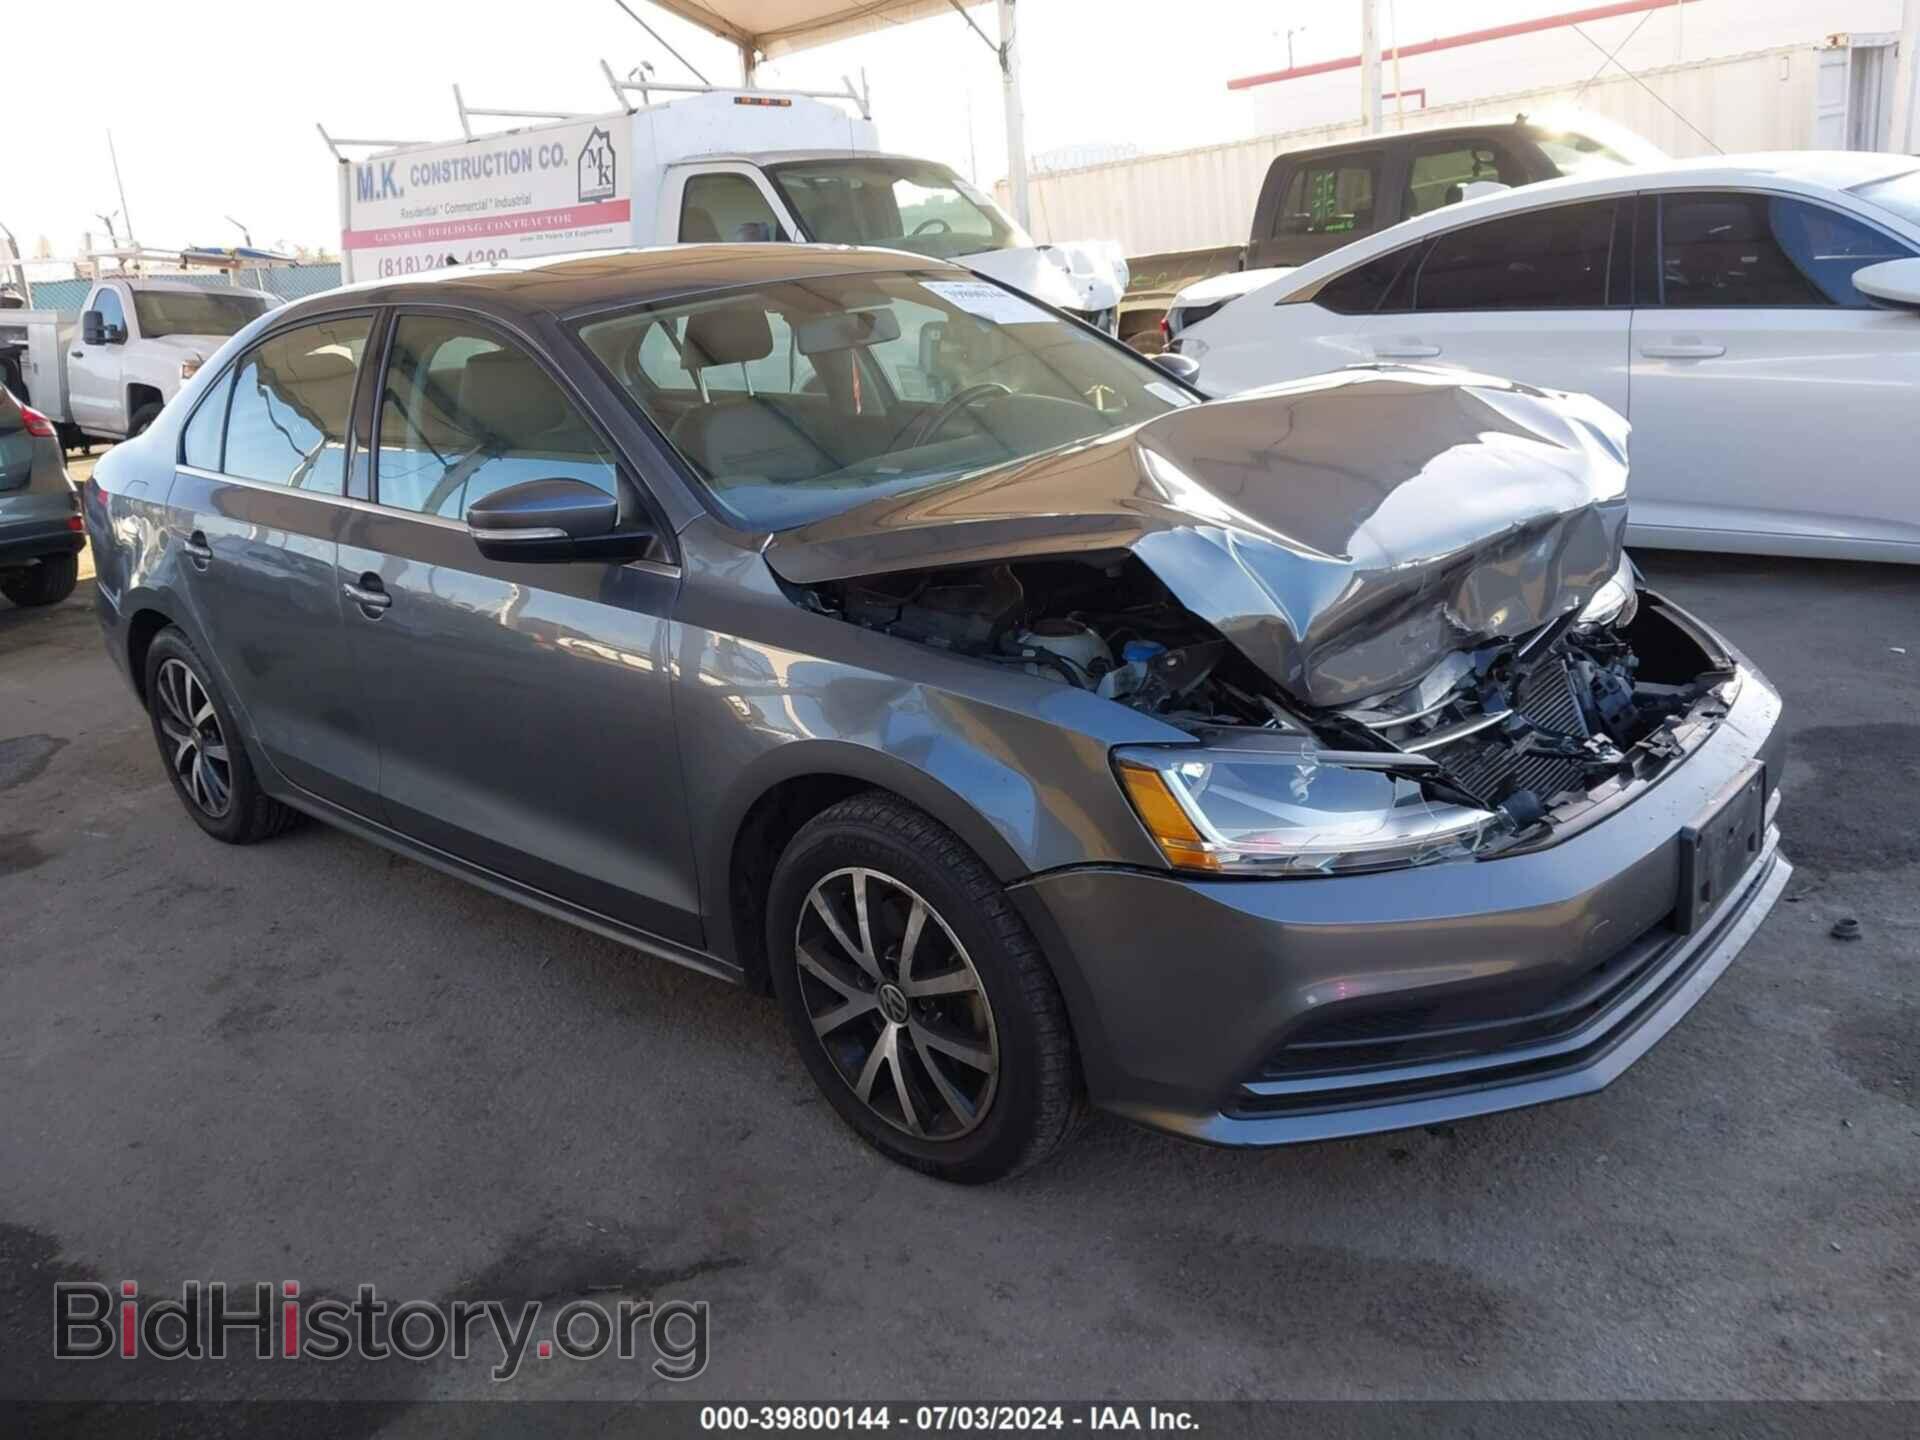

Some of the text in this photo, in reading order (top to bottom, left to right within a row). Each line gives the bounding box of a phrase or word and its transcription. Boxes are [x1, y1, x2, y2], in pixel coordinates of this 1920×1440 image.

[357, 142, 568, 203] M.K. CONSTRUCTION CO.
[428, 223, 483, 238] BUILDING
[487, 213, 573, 232] CONTRACTOR
